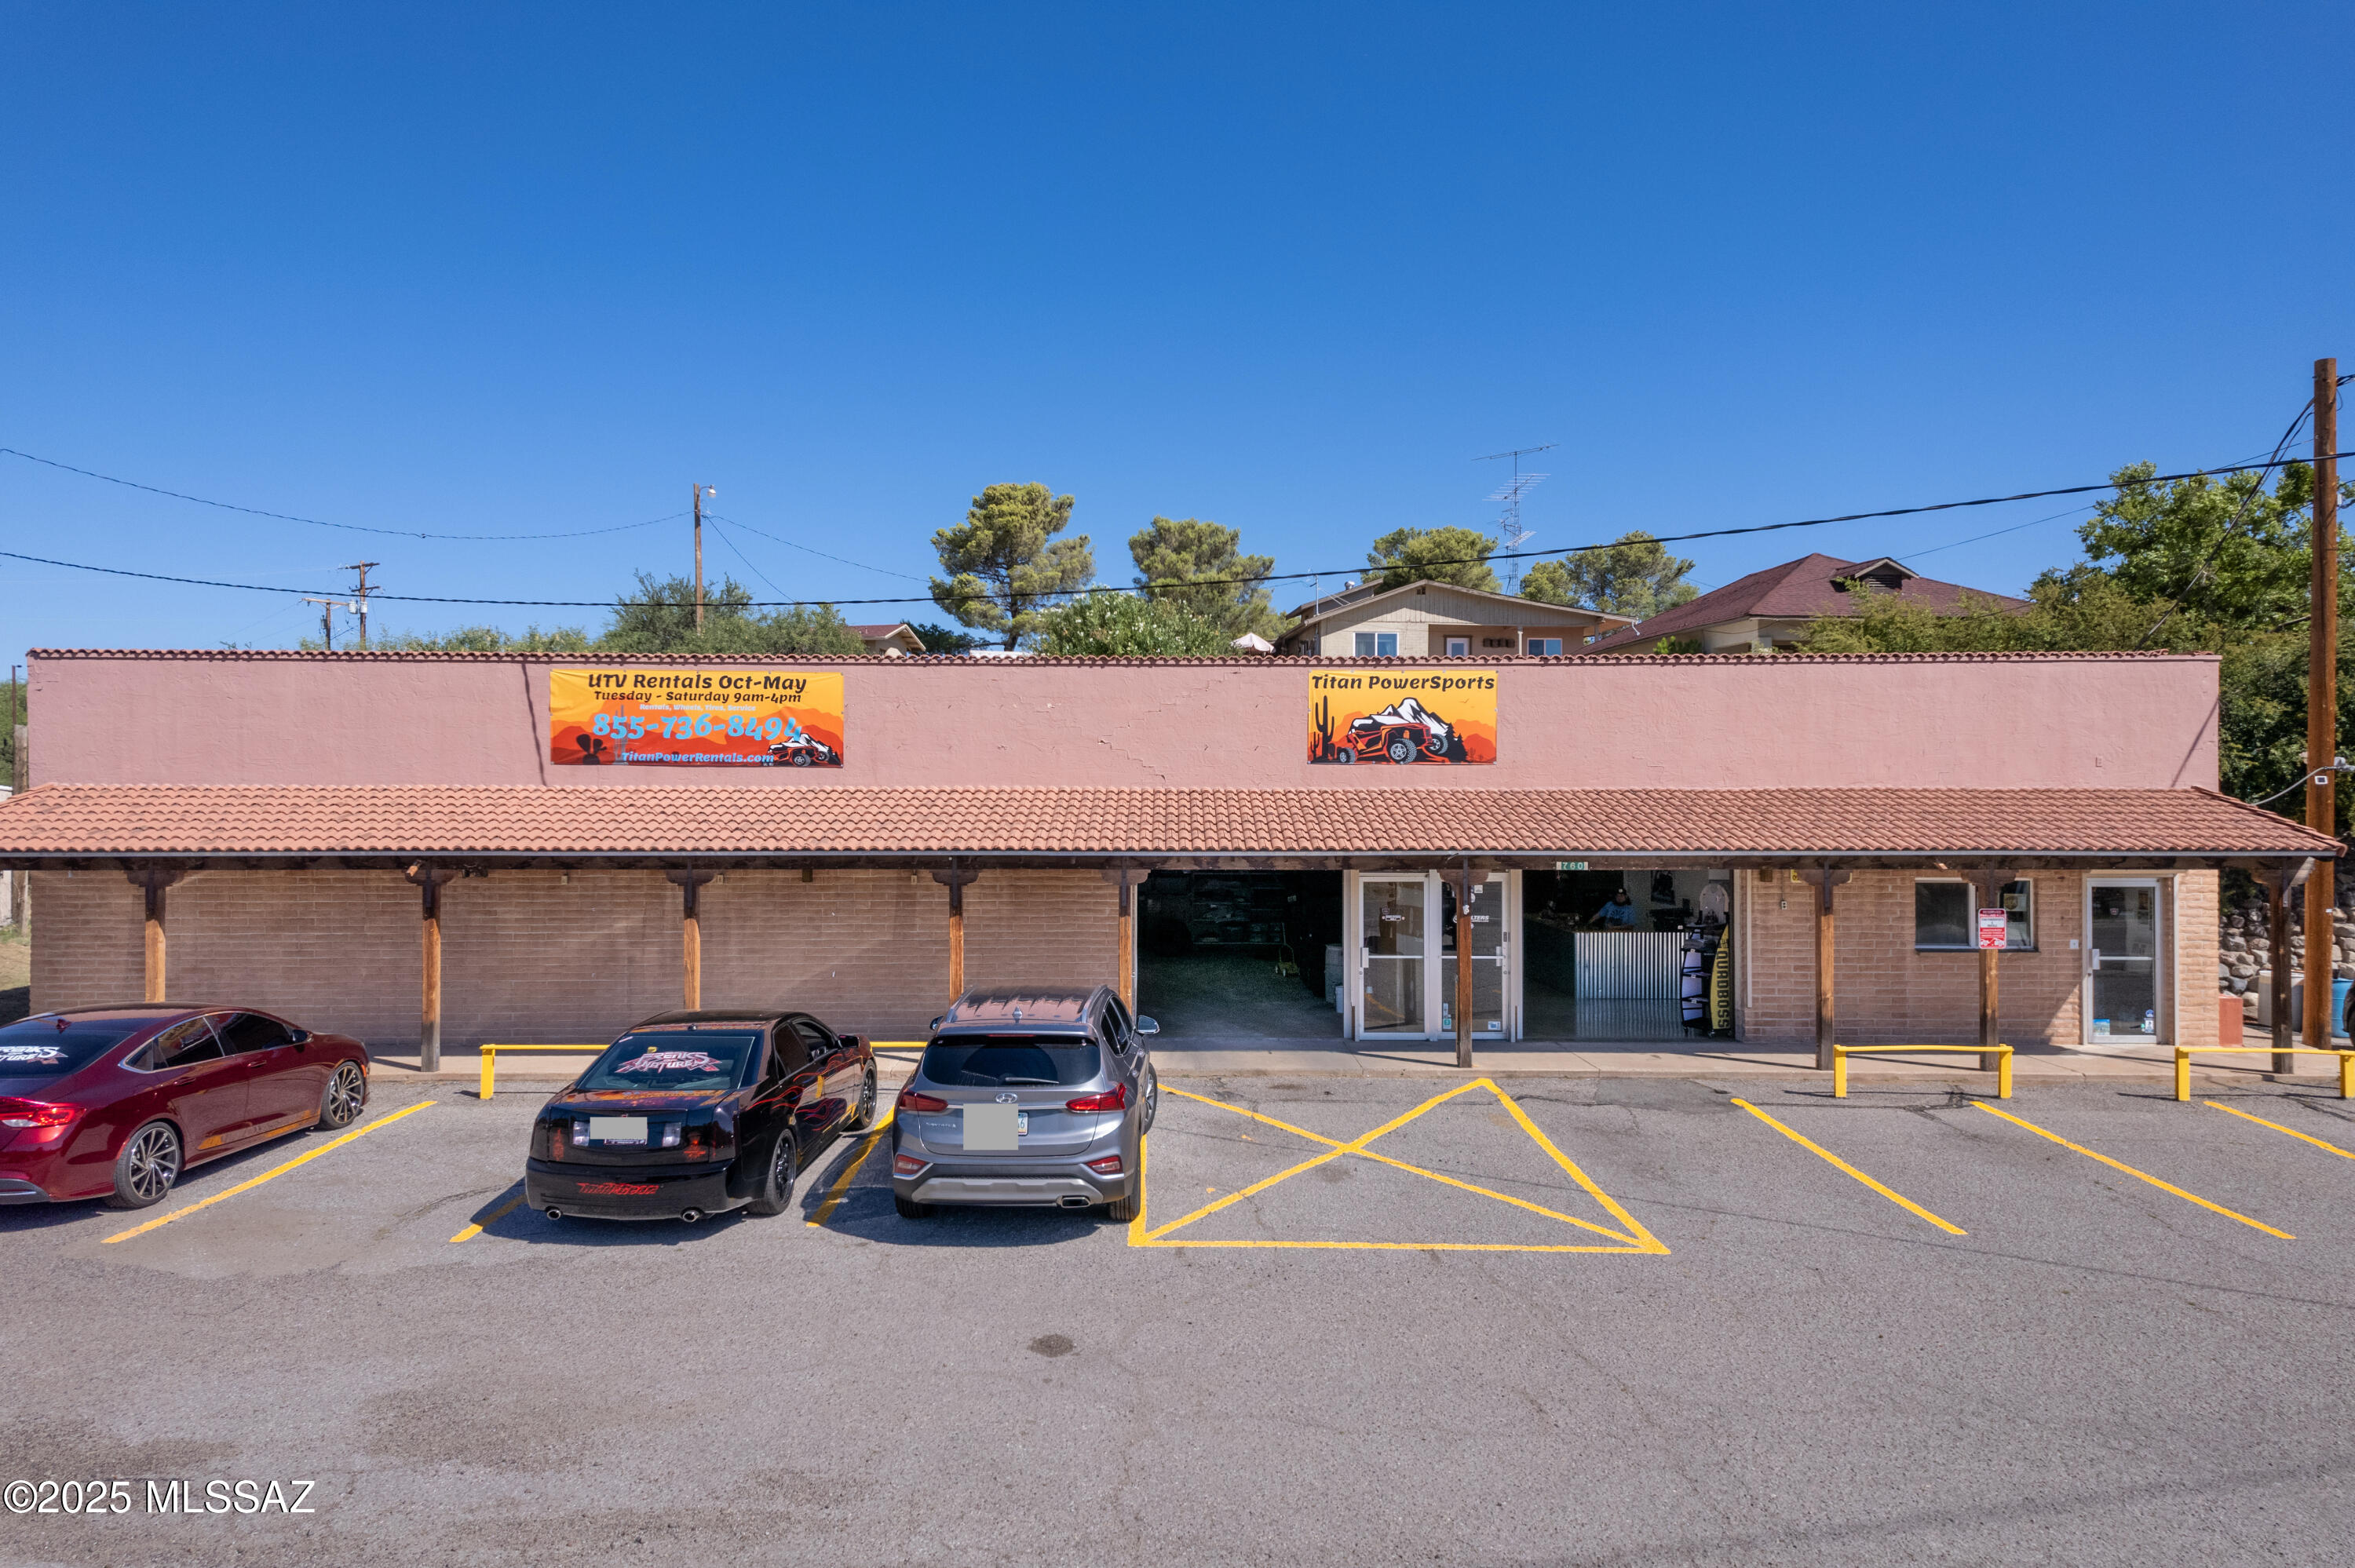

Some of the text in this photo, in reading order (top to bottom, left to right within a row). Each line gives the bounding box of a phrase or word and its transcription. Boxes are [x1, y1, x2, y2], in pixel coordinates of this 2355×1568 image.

[589, 673, 807, 694] UTV Rentals Oct-May
[1312, 674, 1495, 692] Titan PowerSports
[594, 691, 652, 703] Tuesday
[666, 691, 729, 703] Saturday
[734, 691, 801, 705] 9am-4pm
[593, 713, 801, 742] 855-736-8494
[622, 752, 774, 764] TitanPowerRentals.com
[1563, 862, 1583, 870] 760
